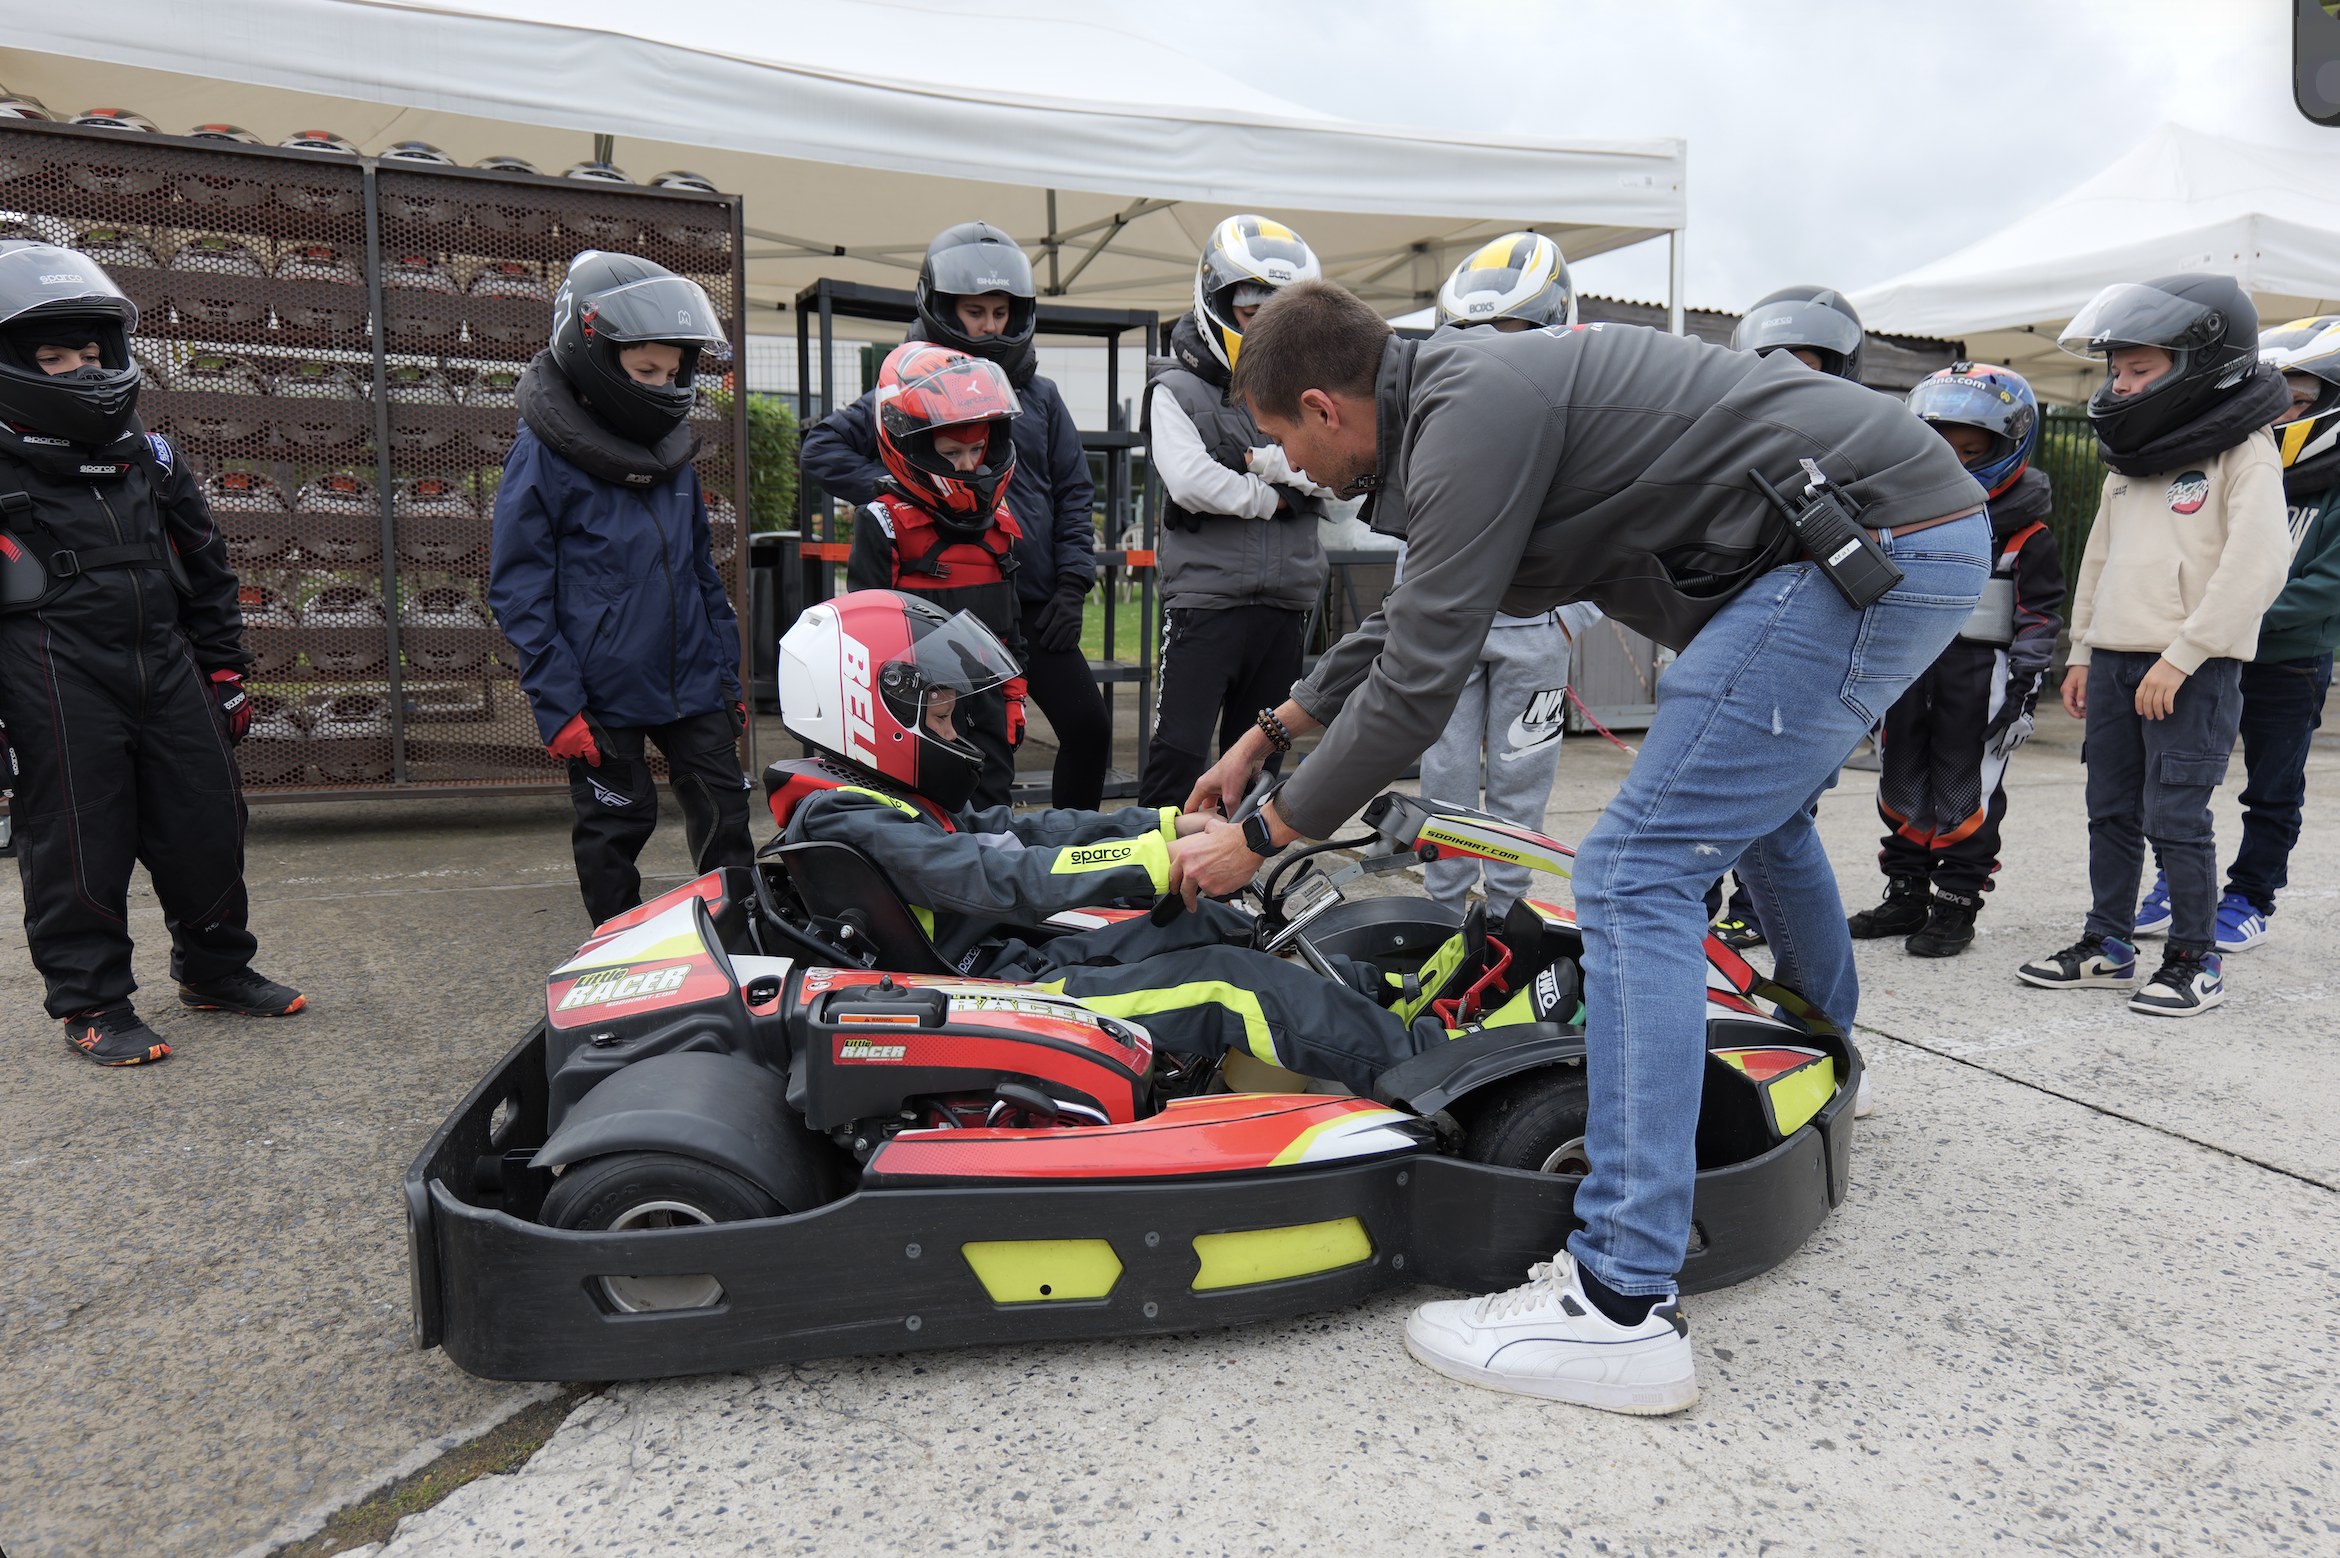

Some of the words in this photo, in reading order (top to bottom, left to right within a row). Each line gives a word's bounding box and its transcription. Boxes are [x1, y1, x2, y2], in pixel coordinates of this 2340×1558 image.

[39, 273, 84, 284] sparco
[976, 277, 1010, 287] SHARK
[1469, 302, 1494, 314] BOXS
[23, 434, 70, 447] sparco
[79, 463, 117, 474] sparco
[1801, 502, 1825, 522] MOTOROLA
[842, 631, 879, 771] BELL
[1426, 830, 1520, 862] SODIKART.COM
[1071, 847, 1132, 865] sparco
[1937, 889, 1972, 907] BOX'S
[957, 945, 982, 974] parco
[555, 964, 692, 1011] RACER
[1539, 969, 1559, 1010] OMP
[605, 989, 679, 1008] SODIKART.COM
[1018, 1011, 1101, 1031] SODIKART.CO
[840, 1046, 906, 1059] RACER
[844, 1039, 872, 1048] Little
